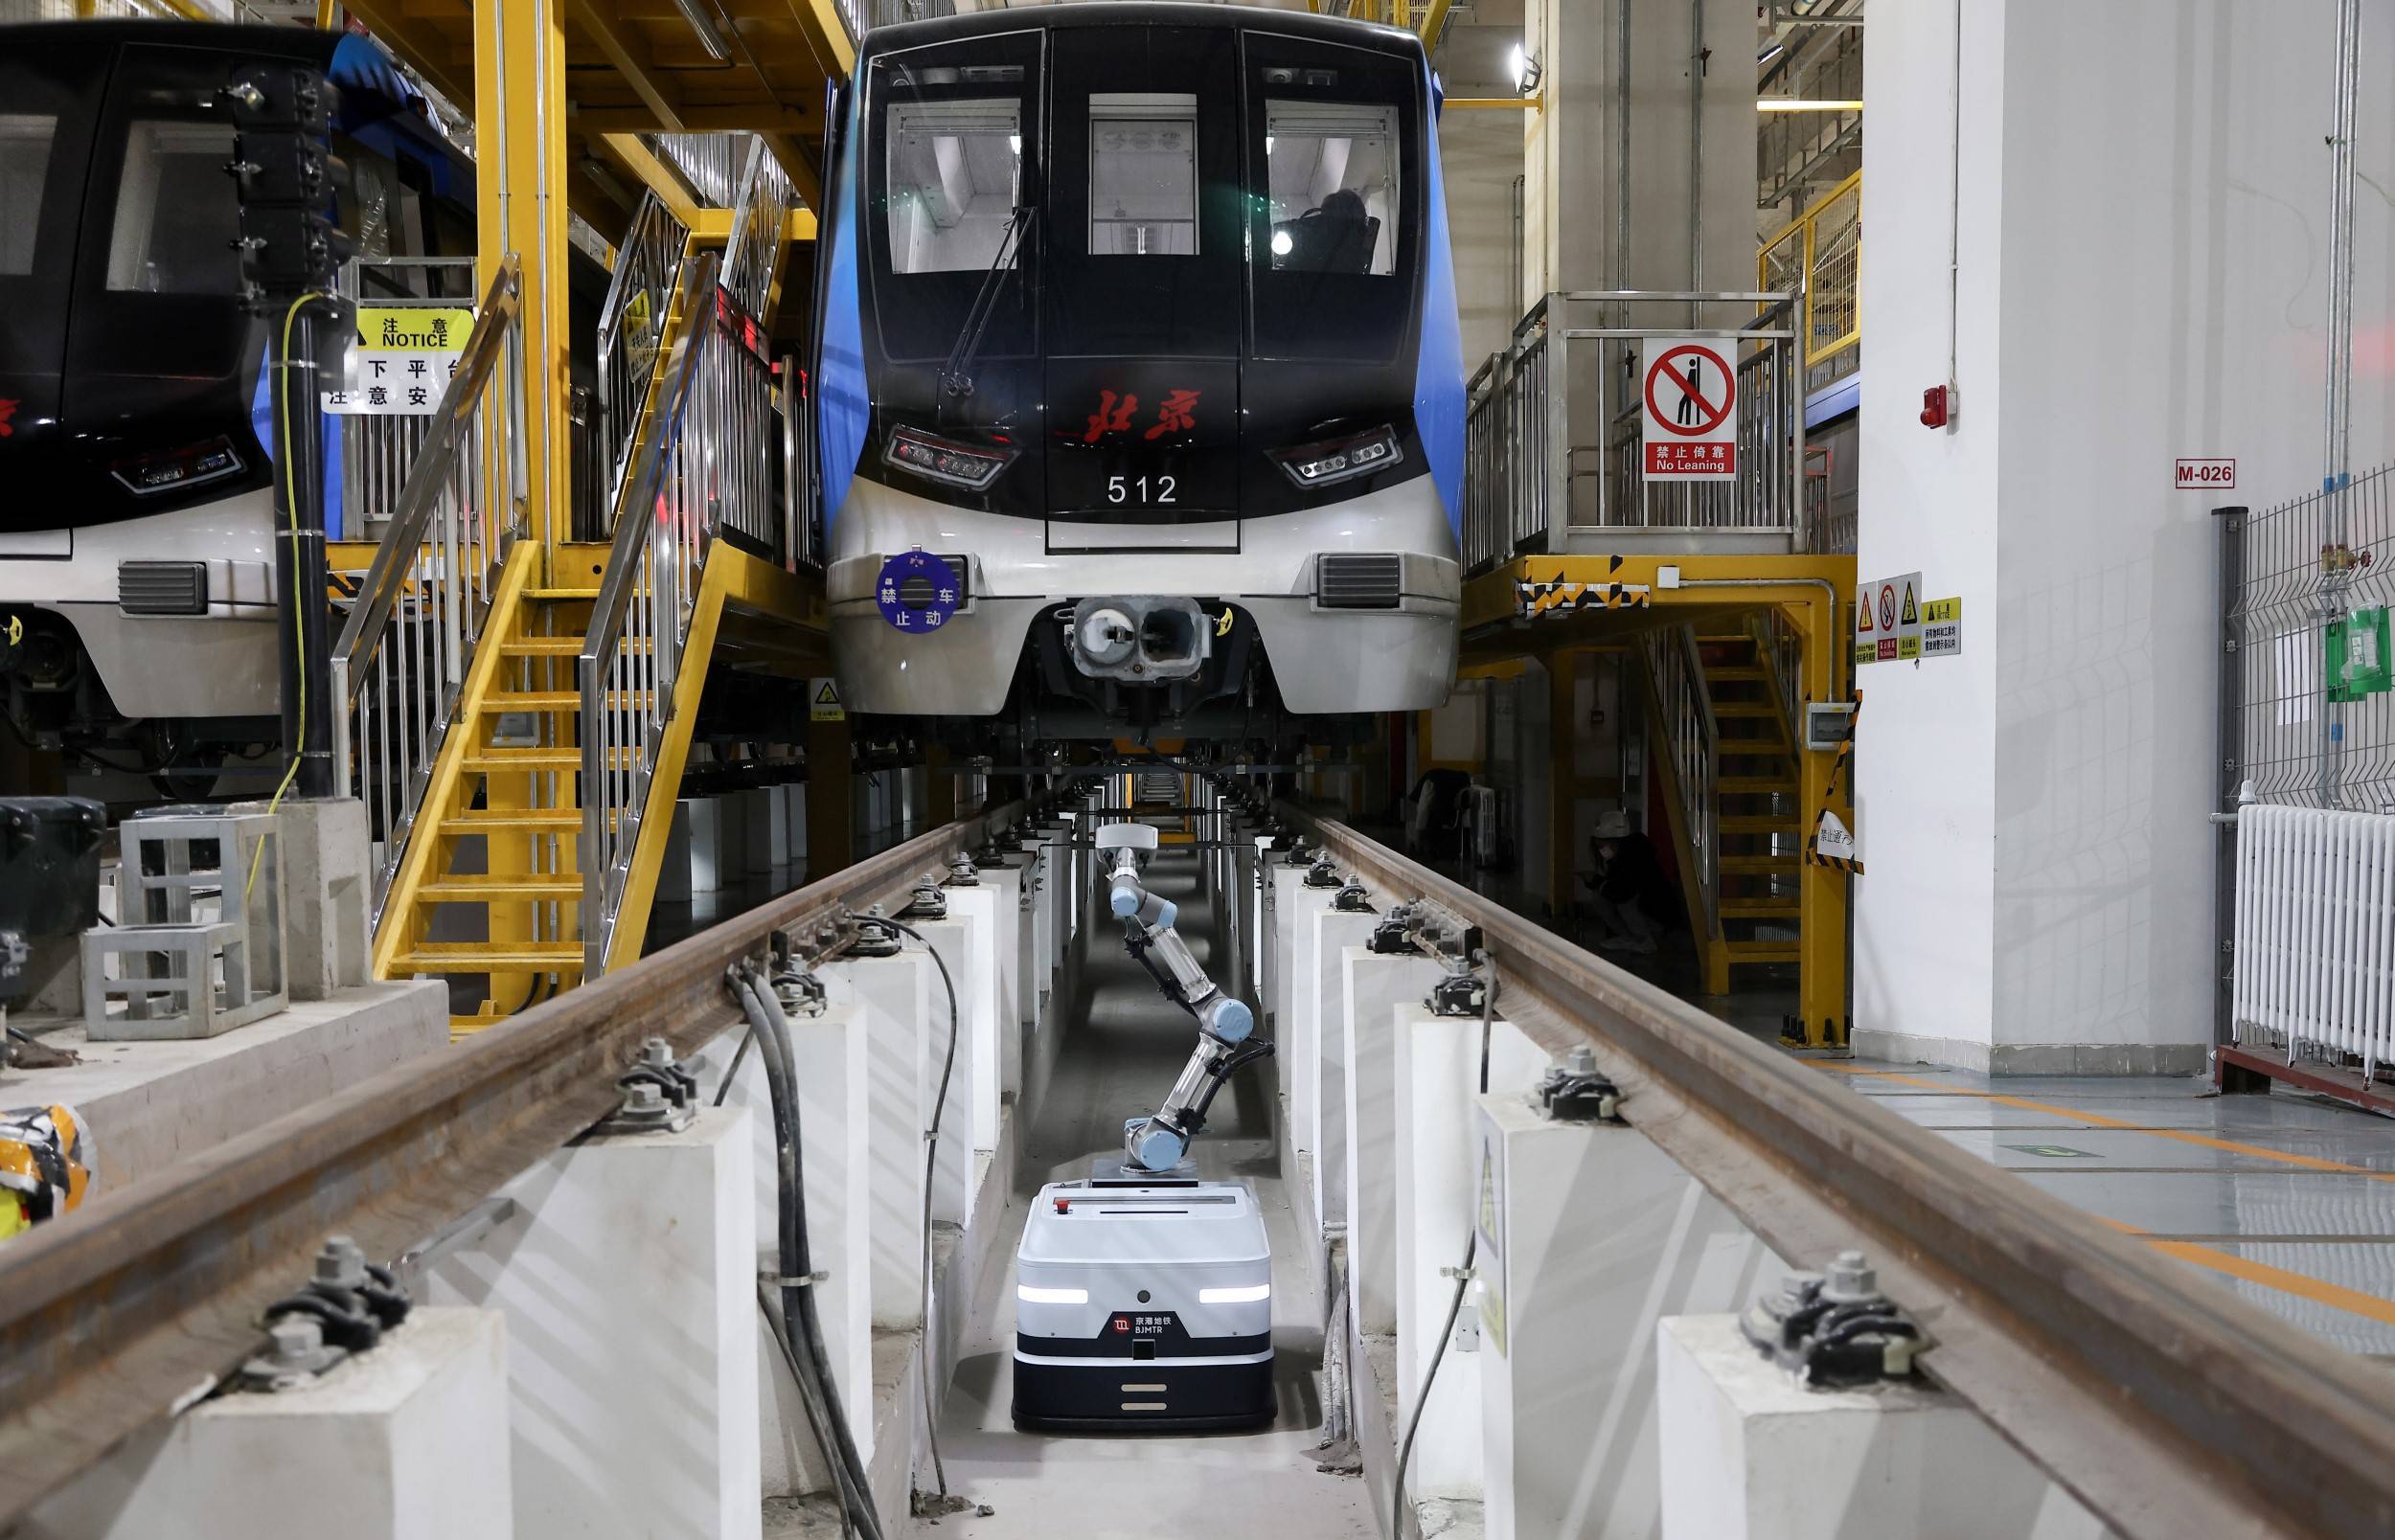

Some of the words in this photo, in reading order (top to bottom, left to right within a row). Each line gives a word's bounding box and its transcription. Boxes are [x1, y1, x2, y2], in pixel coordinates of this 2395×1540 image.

[383, 318, 447, 333] 注意
[383, 333, 447, 347] NOTICE
[1083, 389, 1203, 442] 北京
[1656, 444, 1725, 459] 禁止倚靠
[1656, 460, 1674, 470] No
[1677, 460, 1725, 472] Leaning
[2178, 465, 2232, 482] M-026
[1107, 475, 1176, 503] 512
[1134, 1317, 1172, 1325] 京港地铁
[1134, 1325, 1163, 1334] BJMTR
